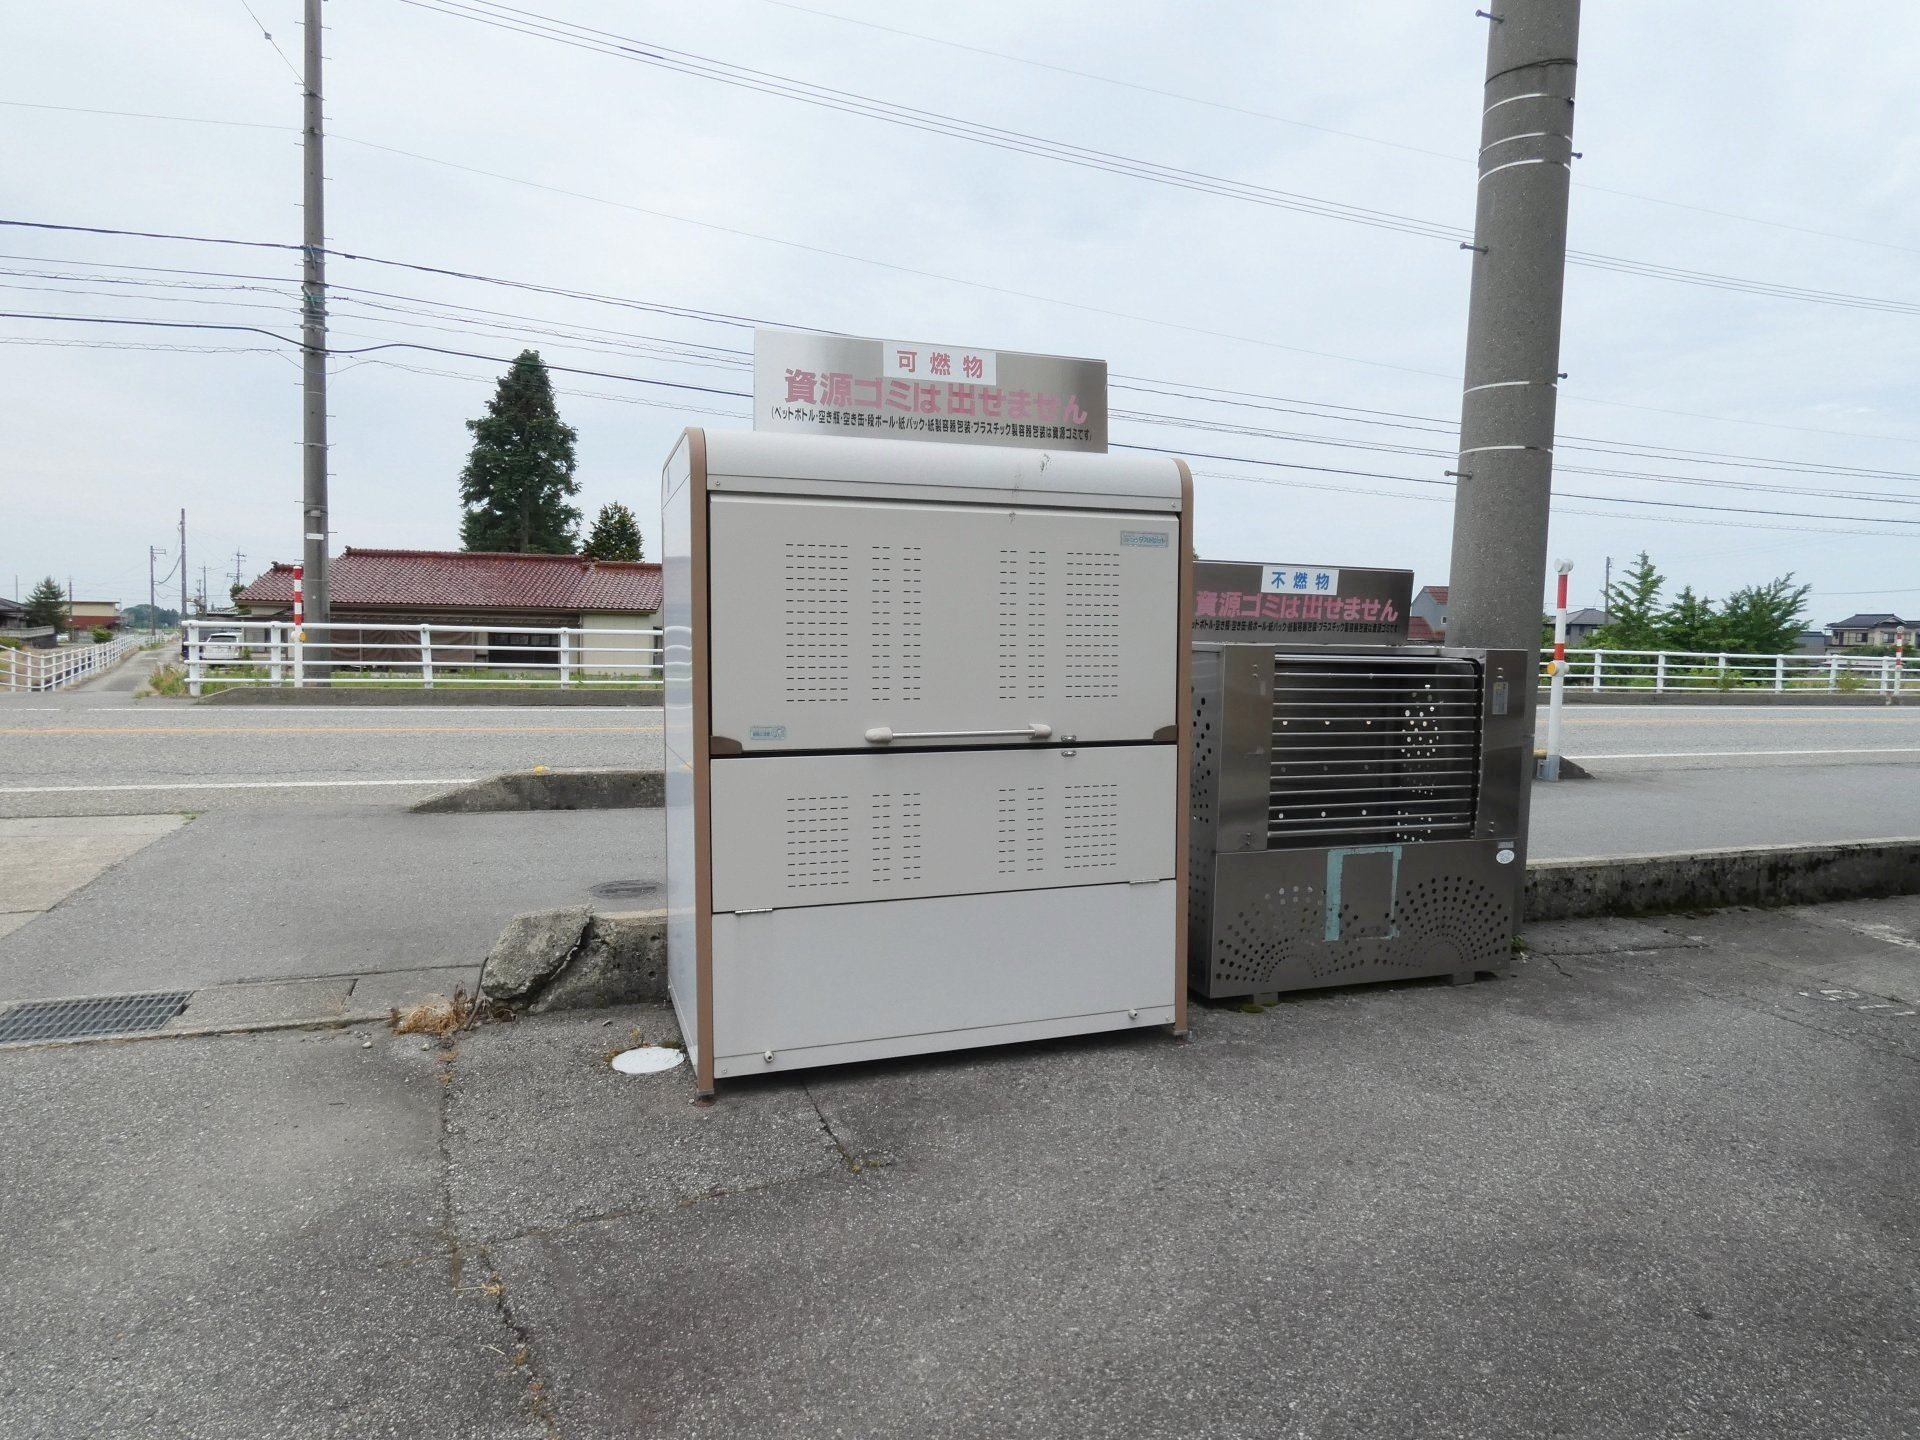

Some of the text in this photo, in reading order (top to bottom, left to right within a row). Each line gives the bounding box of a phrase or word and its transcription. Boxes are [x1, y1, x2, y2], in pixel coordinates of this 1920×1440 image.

[896, 349, 984, 379] 可燃物
[784, 367, 1088, 425] 資源ゴミは出せません
[1271, 571, 1330, 591] 不燃物
[1194, 590, 1398, 622] 資源ゴミは出せません
